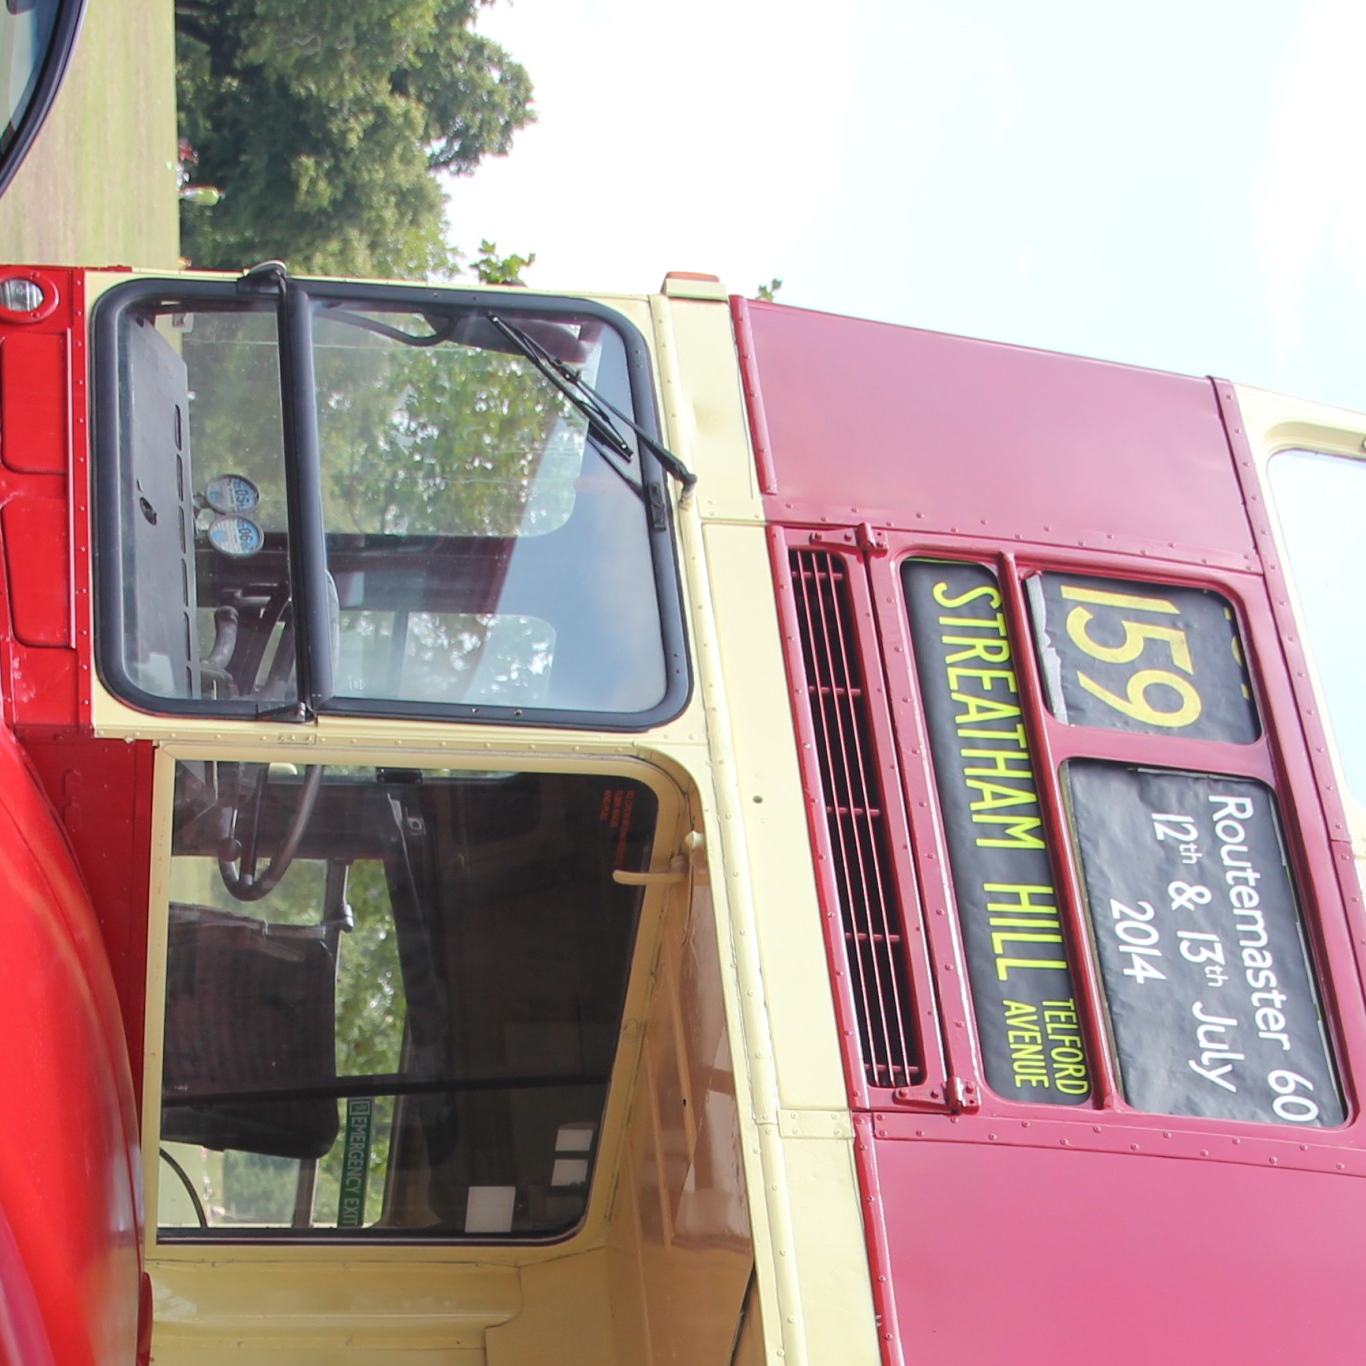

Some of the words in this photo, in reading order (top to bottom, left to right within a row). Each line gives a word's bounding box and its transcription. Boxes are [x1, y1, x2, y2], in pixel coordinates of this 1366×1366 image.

[1059, 584, 1203, 727] 159
[932, 582, 1046, 850] STREATHAM
[1152, 813, 1199, 864] 12th
[983, 883, 1067, 980] HILL
[1169, 881, 1211, 911] &
[1110, 898, 1166, 984] 2014
[1179, 931, 1226, 987] 13th
[1208, 794, 1289, 1050] Routemaster
[1267, 1069, 1319, 1122] 60
[1002, 1000, 1048, 1088] AVENUE
[1043, 998, 1089, 1094] TELFORD
[1189, 1001, 1238, 1093] July
[346, 1117, 367, 1194] EMERGENCY
[343, 1198, 359, 1225] EXIT
